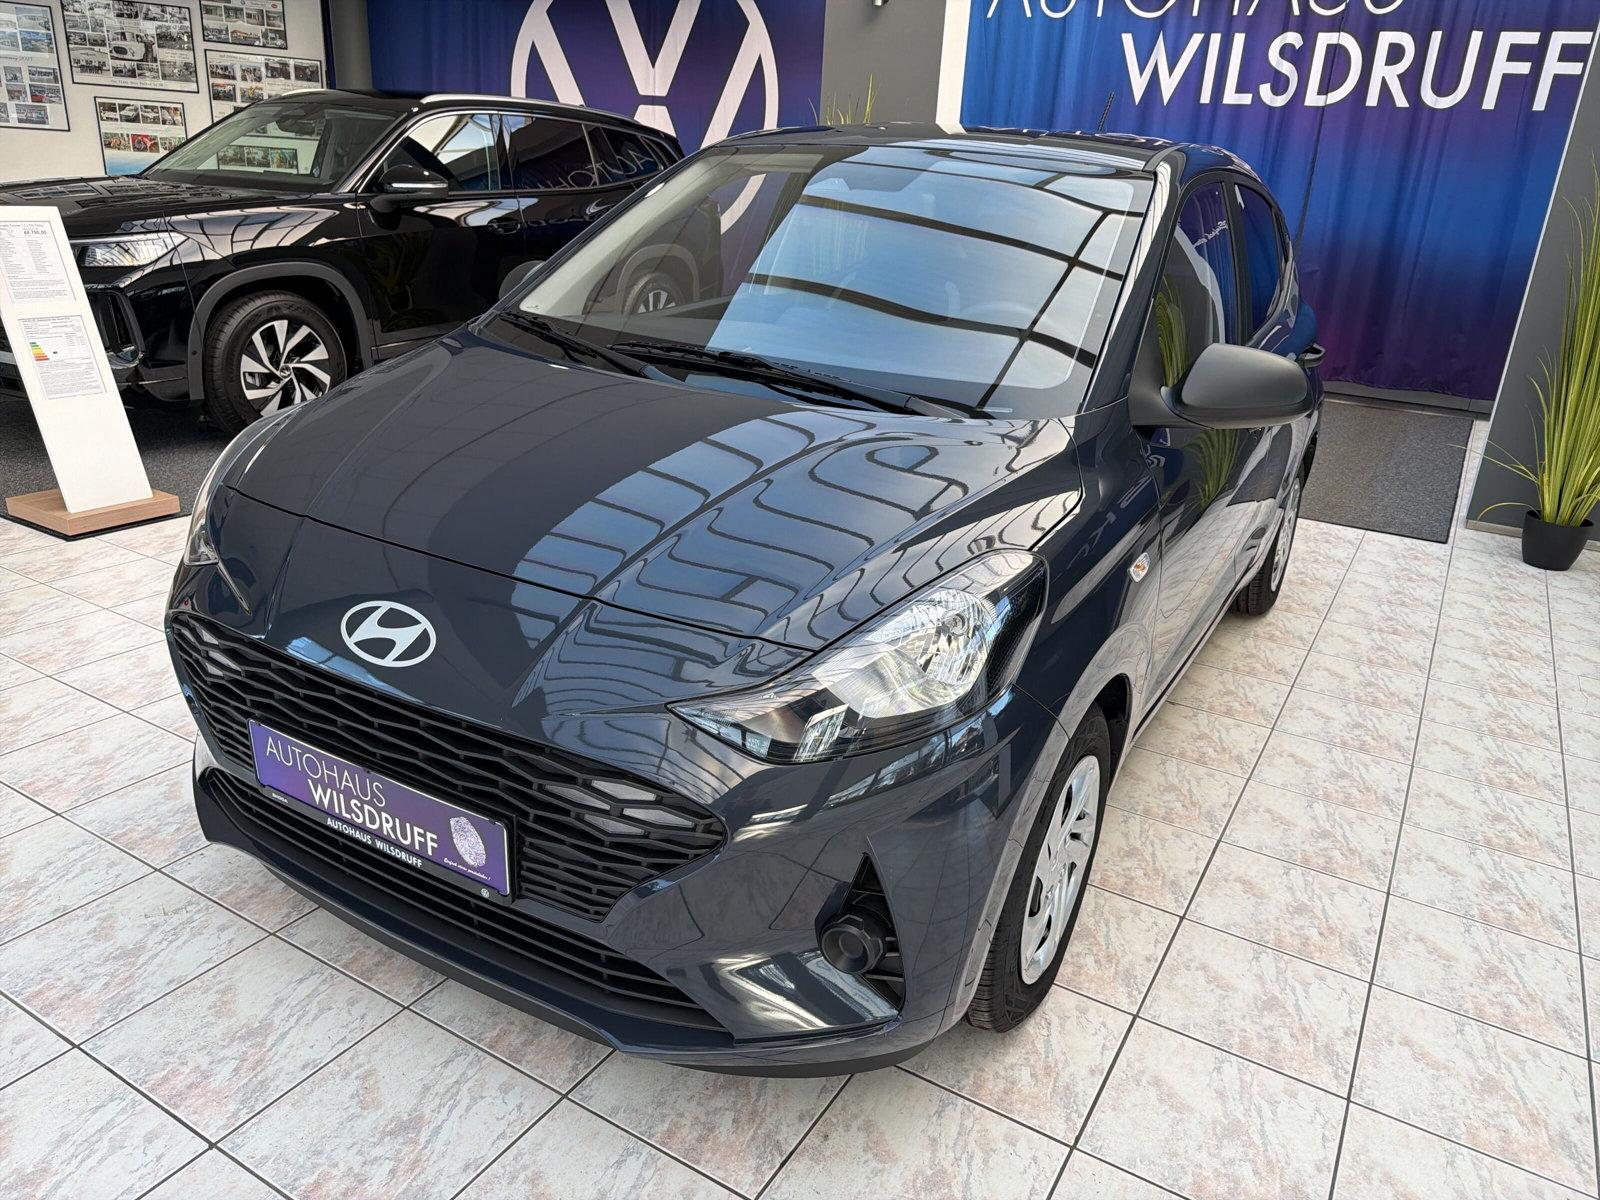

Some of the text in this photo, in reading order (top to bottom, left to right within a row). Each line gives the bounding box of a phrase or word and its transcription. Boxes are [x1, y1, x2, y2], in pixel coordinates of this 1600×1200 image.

[1121, 30, 1592, 111] WILSDRUFF
[266, 736, 386, 807] AUTOHAUS
[307, 778, 438, 856] WILSDRUFF
[327, 817, 423, 868] AUTOHAUS WILSDRUFF
